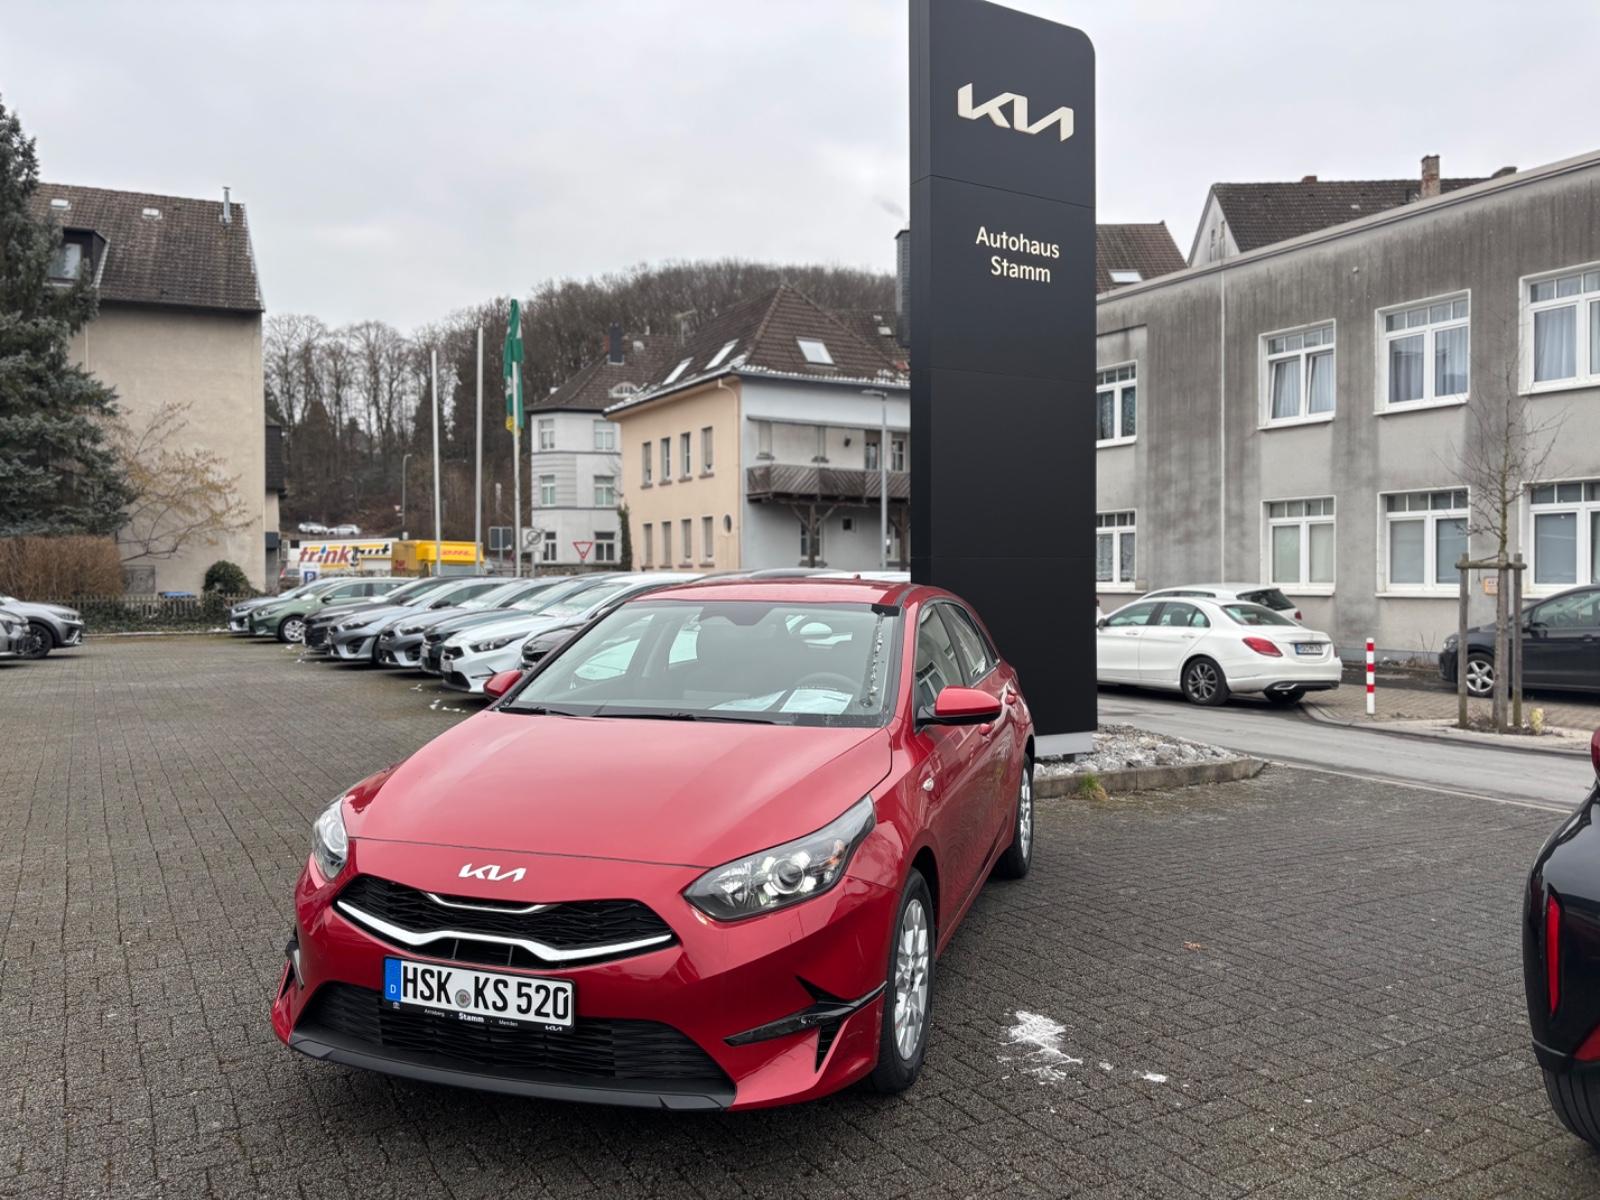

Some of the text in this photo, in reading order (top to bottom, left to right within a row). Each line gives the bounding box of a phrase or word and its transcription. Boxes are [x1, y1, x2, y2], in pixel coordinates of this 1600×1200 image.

[958, 83, 1074, 142] KIA
[976, 226, 1060, 259] Autohaus
[991, 256, 1050, 283] Stamm
[458, 863, 527, 882] KIA
[390, 984, 397, 994] D
[402, 965, 569, 1020] HSK KS 520
[458, 1012, 485, 1023] Stamm
